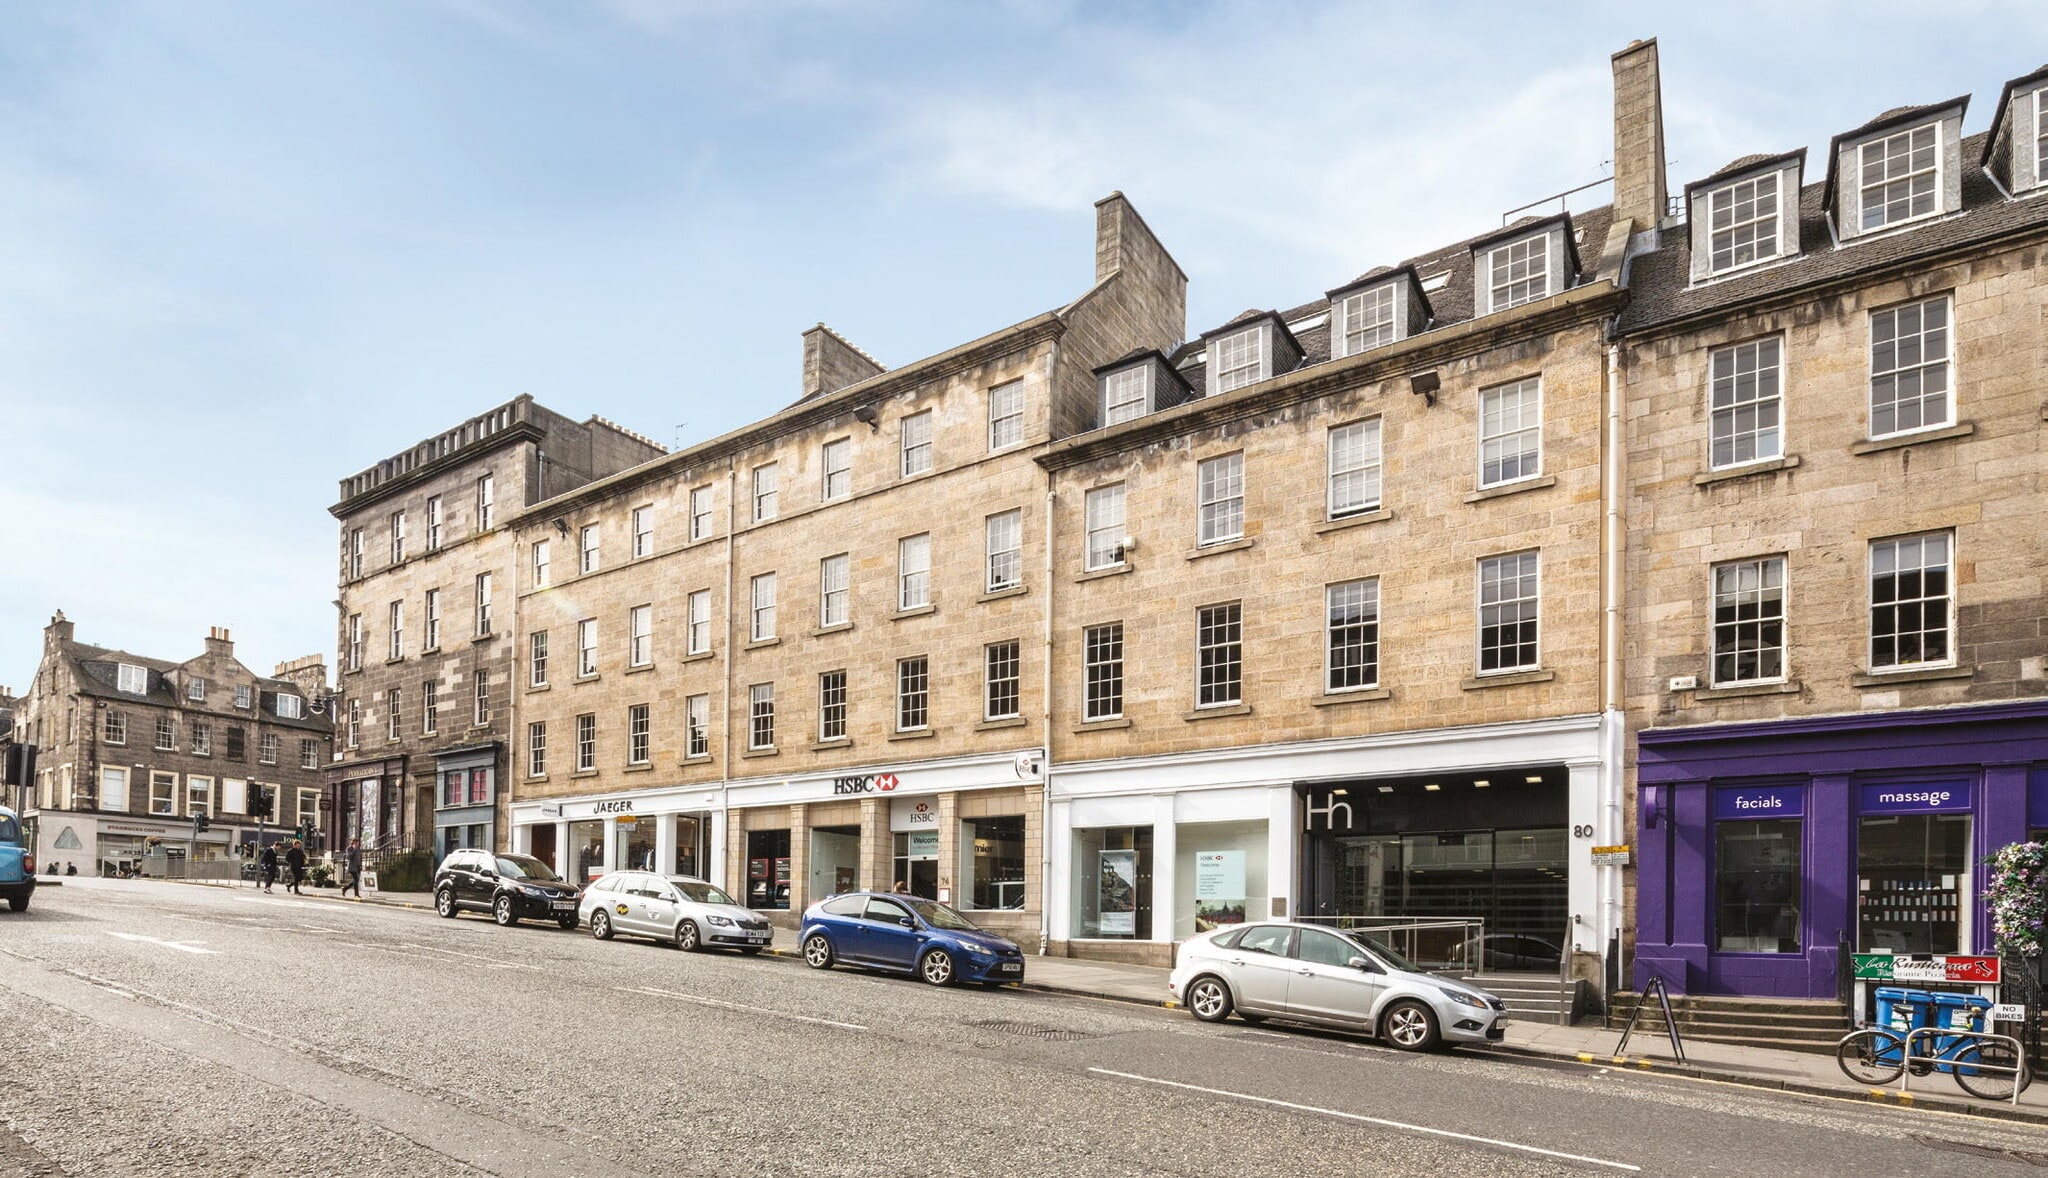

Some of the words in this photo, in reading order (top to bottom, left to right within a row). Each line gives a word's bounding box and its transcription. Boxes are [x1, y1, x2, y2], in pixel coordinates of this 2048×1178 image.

[833, 775, 875, 795] HSBC
[1735, 794, 1782, 809] facials
[1879, 791, 1951, 806] massage
[593, 800, 633, 815] JAEGER
[910, 812, 935, 824] HSBC
[1573, 824, 1594, 838] 80
